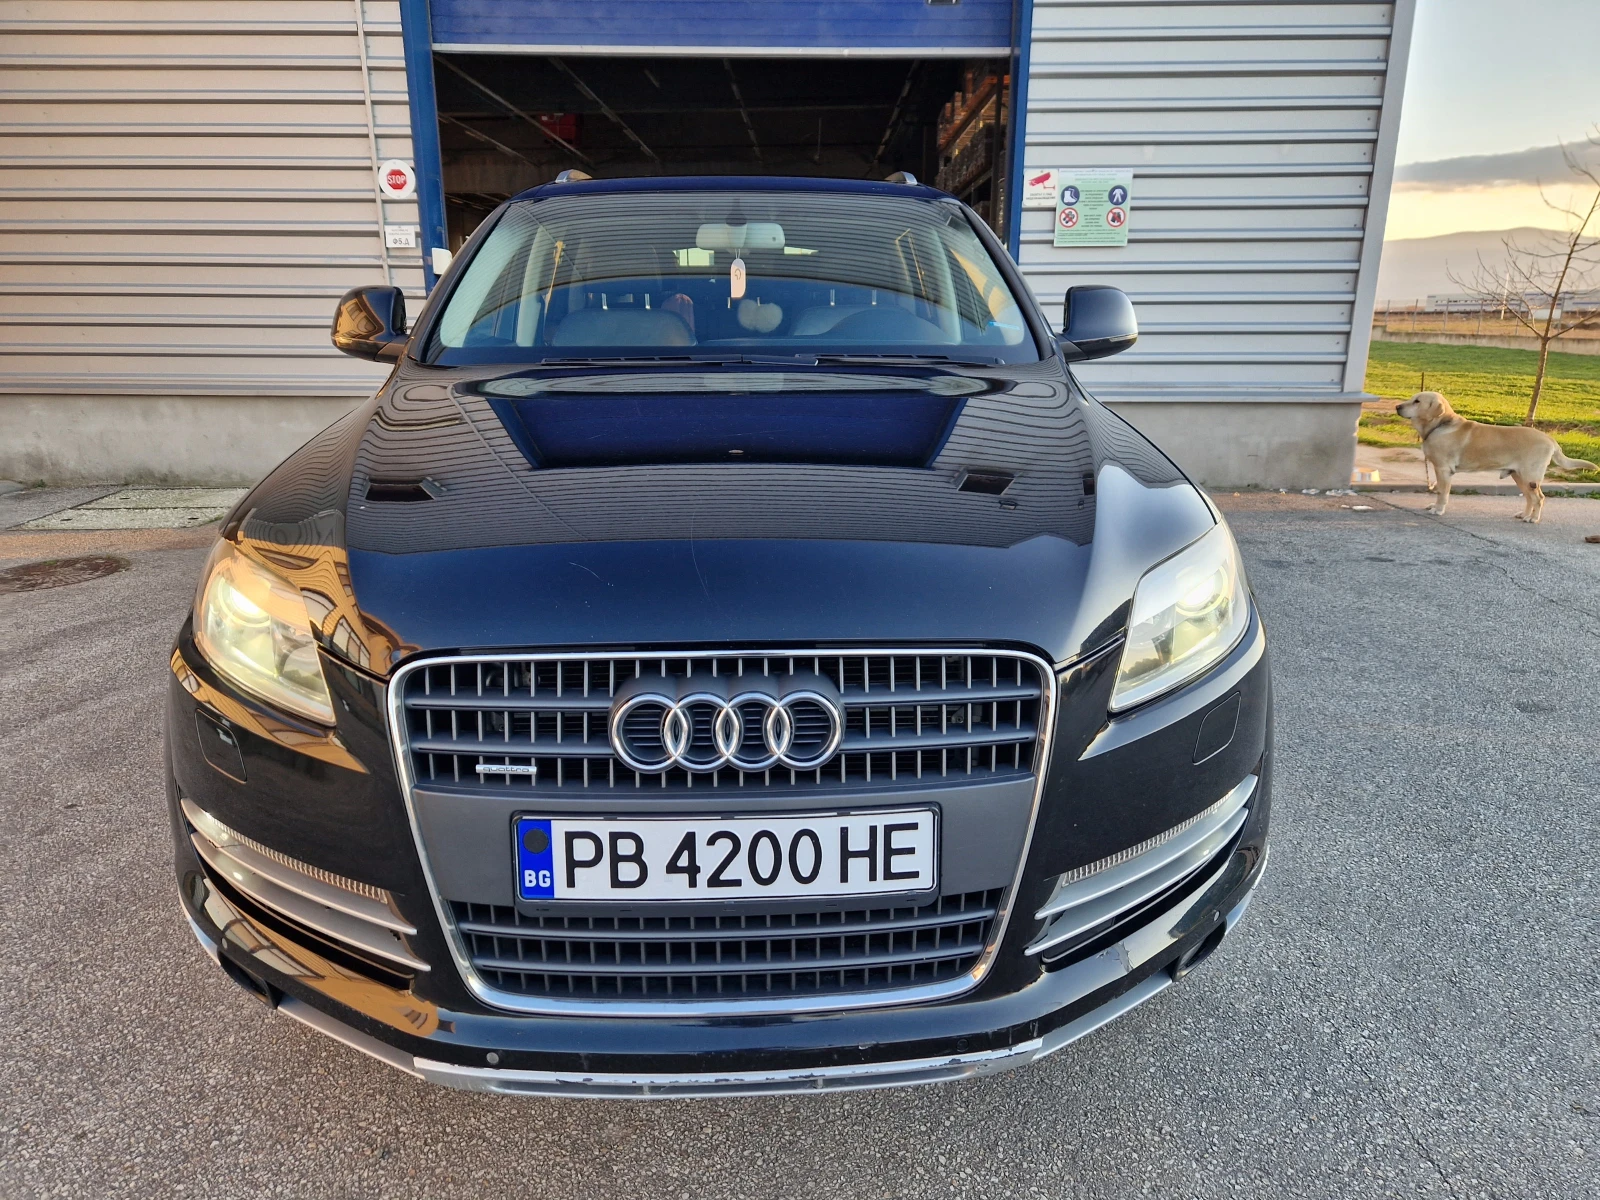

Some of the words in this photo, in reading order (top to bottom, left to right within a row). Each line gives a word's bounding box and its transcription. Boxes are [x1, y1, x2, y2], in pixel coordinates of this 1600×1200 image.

[387, 174, 406, 185] STOP
[563, 830, 649, 889] PB
[665, 829, 823, 889] 4200
[839, 822, 920, 884] HE
[523, 869, 551, 888] BG
